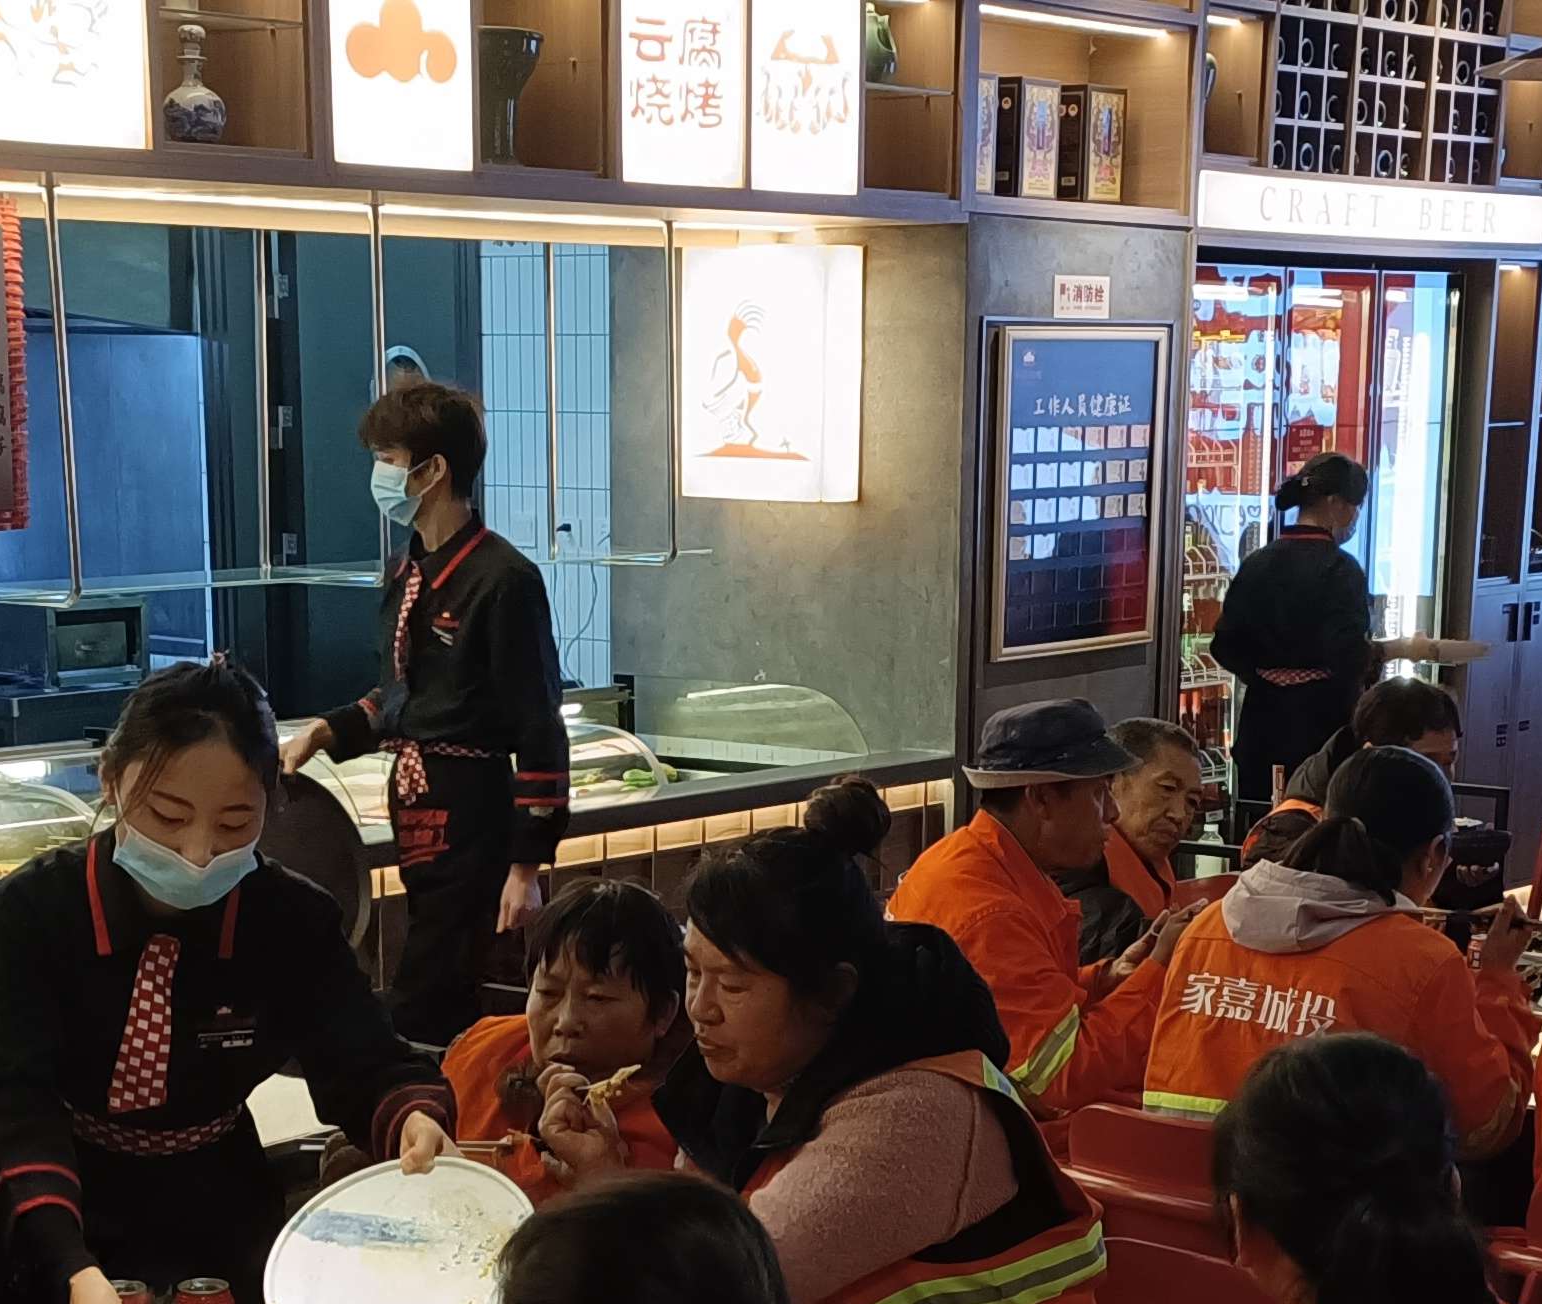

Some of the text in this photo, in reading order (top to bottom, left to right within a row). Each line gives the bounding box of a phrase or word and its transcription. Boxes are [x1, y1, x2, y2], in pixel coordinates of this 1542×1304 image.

[629, 16, 722, 69] 云腐
[629, 74, 723, 129] 烧烤
[1260, 184, 1497, 234] CRAFT BEER
[1033, 393, 1132, 417] 工作人员健康证
[1180, 971, 1339, 1038] 家嘉城投
